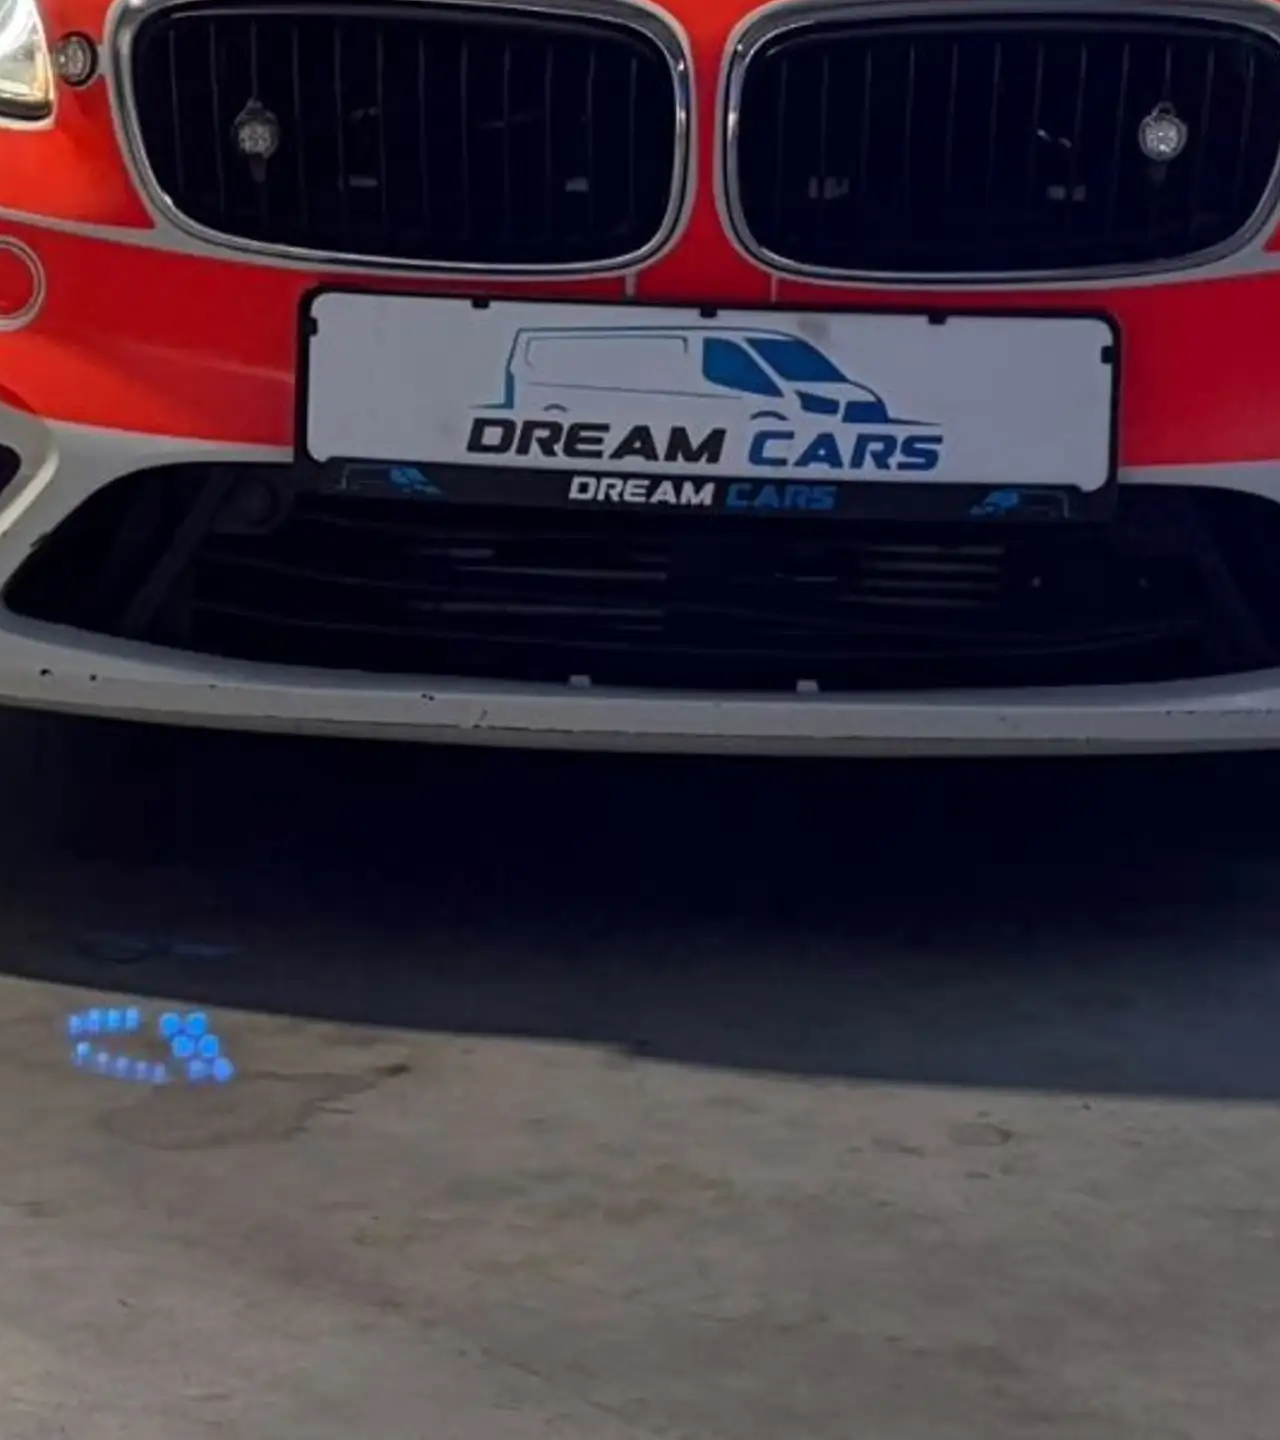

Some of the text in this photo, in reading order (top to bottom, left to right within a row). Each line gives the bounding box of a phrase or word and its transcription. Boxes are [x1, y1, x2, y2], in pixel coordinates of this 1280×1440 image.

[466, 416, 944, 471] DREAM CARS
[568, 474, 838, 511] DREAM CARS
